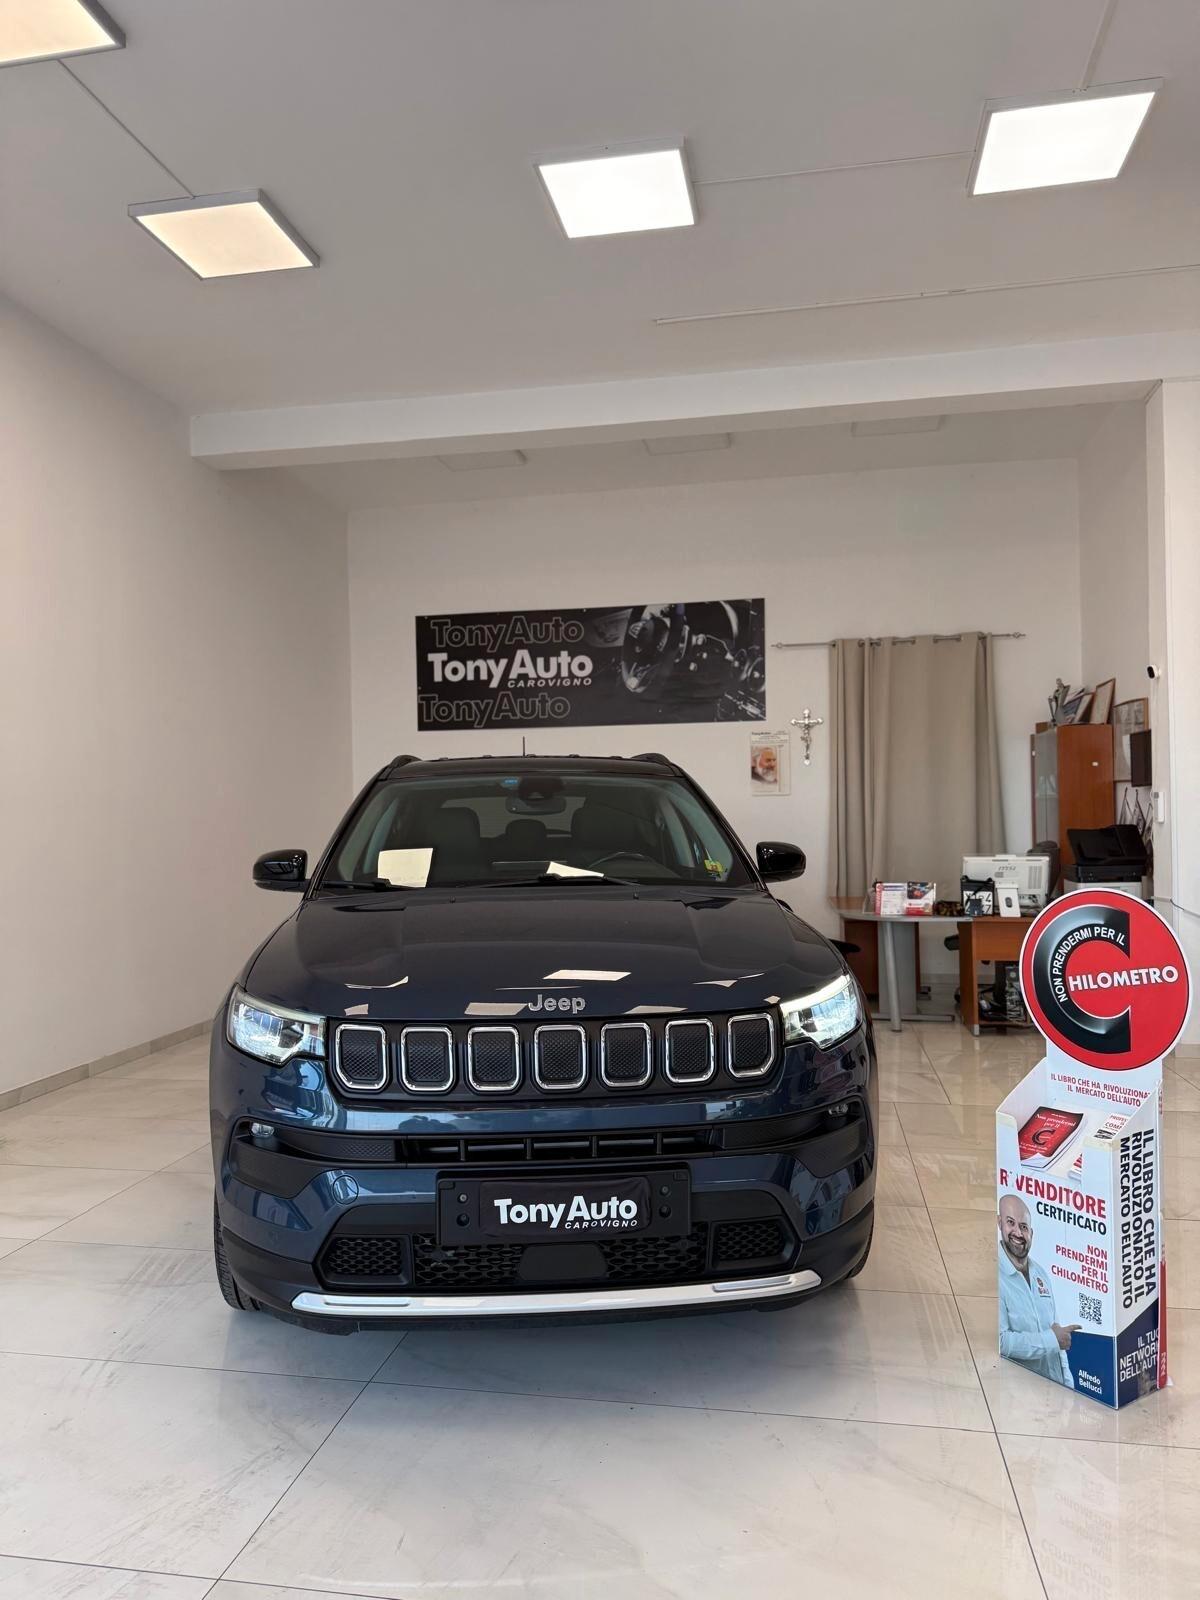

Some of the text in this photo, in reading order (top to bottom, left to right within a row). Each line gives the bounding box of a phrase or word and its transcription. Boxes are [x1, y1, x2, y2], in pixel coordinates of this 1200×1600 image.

[427, 649, 593, 688] TonyAuto
[508, 678, 592, 689] CAROVIGNO
[1053, 927, 1125, 1002] NON PRENDERMI PER IL
[528, 994, 586, 1014] Jeep
[1058, 1074, 1076, 1085] LIBRO
[1077, 1078, 1090, 1087] CHE
[1091, 1081, 1100, 1089] HA
[1103, 1083, 1150, 1099] RIVOLUZIONA
[1067, 1084, 1141, 1107] IL MERCATO DELL'AUTO
[1120, 1136, 1130, 1217] MERCATO
[565, 1220, 638, 1229] CAROVIGNO
[1036, 1201, 1107, 1236] CERTIFICATO
[1132, 1131, 1144, 1303] RIVOLUZIONATO IL
[1143, 1128, 1156, 1296] IL LIBRO CHE HA
[1055, 1245, 1108, 1271] PRENDERMI
[1087, 1245, 1108, 1260] NON
[1121, 1221, 1132, 1309] DELL'AUTO
[1051, 1265, 1109, 1294] CHILOMETRO
[1081, 1265, 1109, 1283] PER IL
[1138, 1336, 1145, 1348] IL
[1078, 1369, 1101, 1385] Alfredo
[1120, 1354, 1157, 1382] DELL'AUT
[1078, 1378, 1102, 1395] Bellucci
